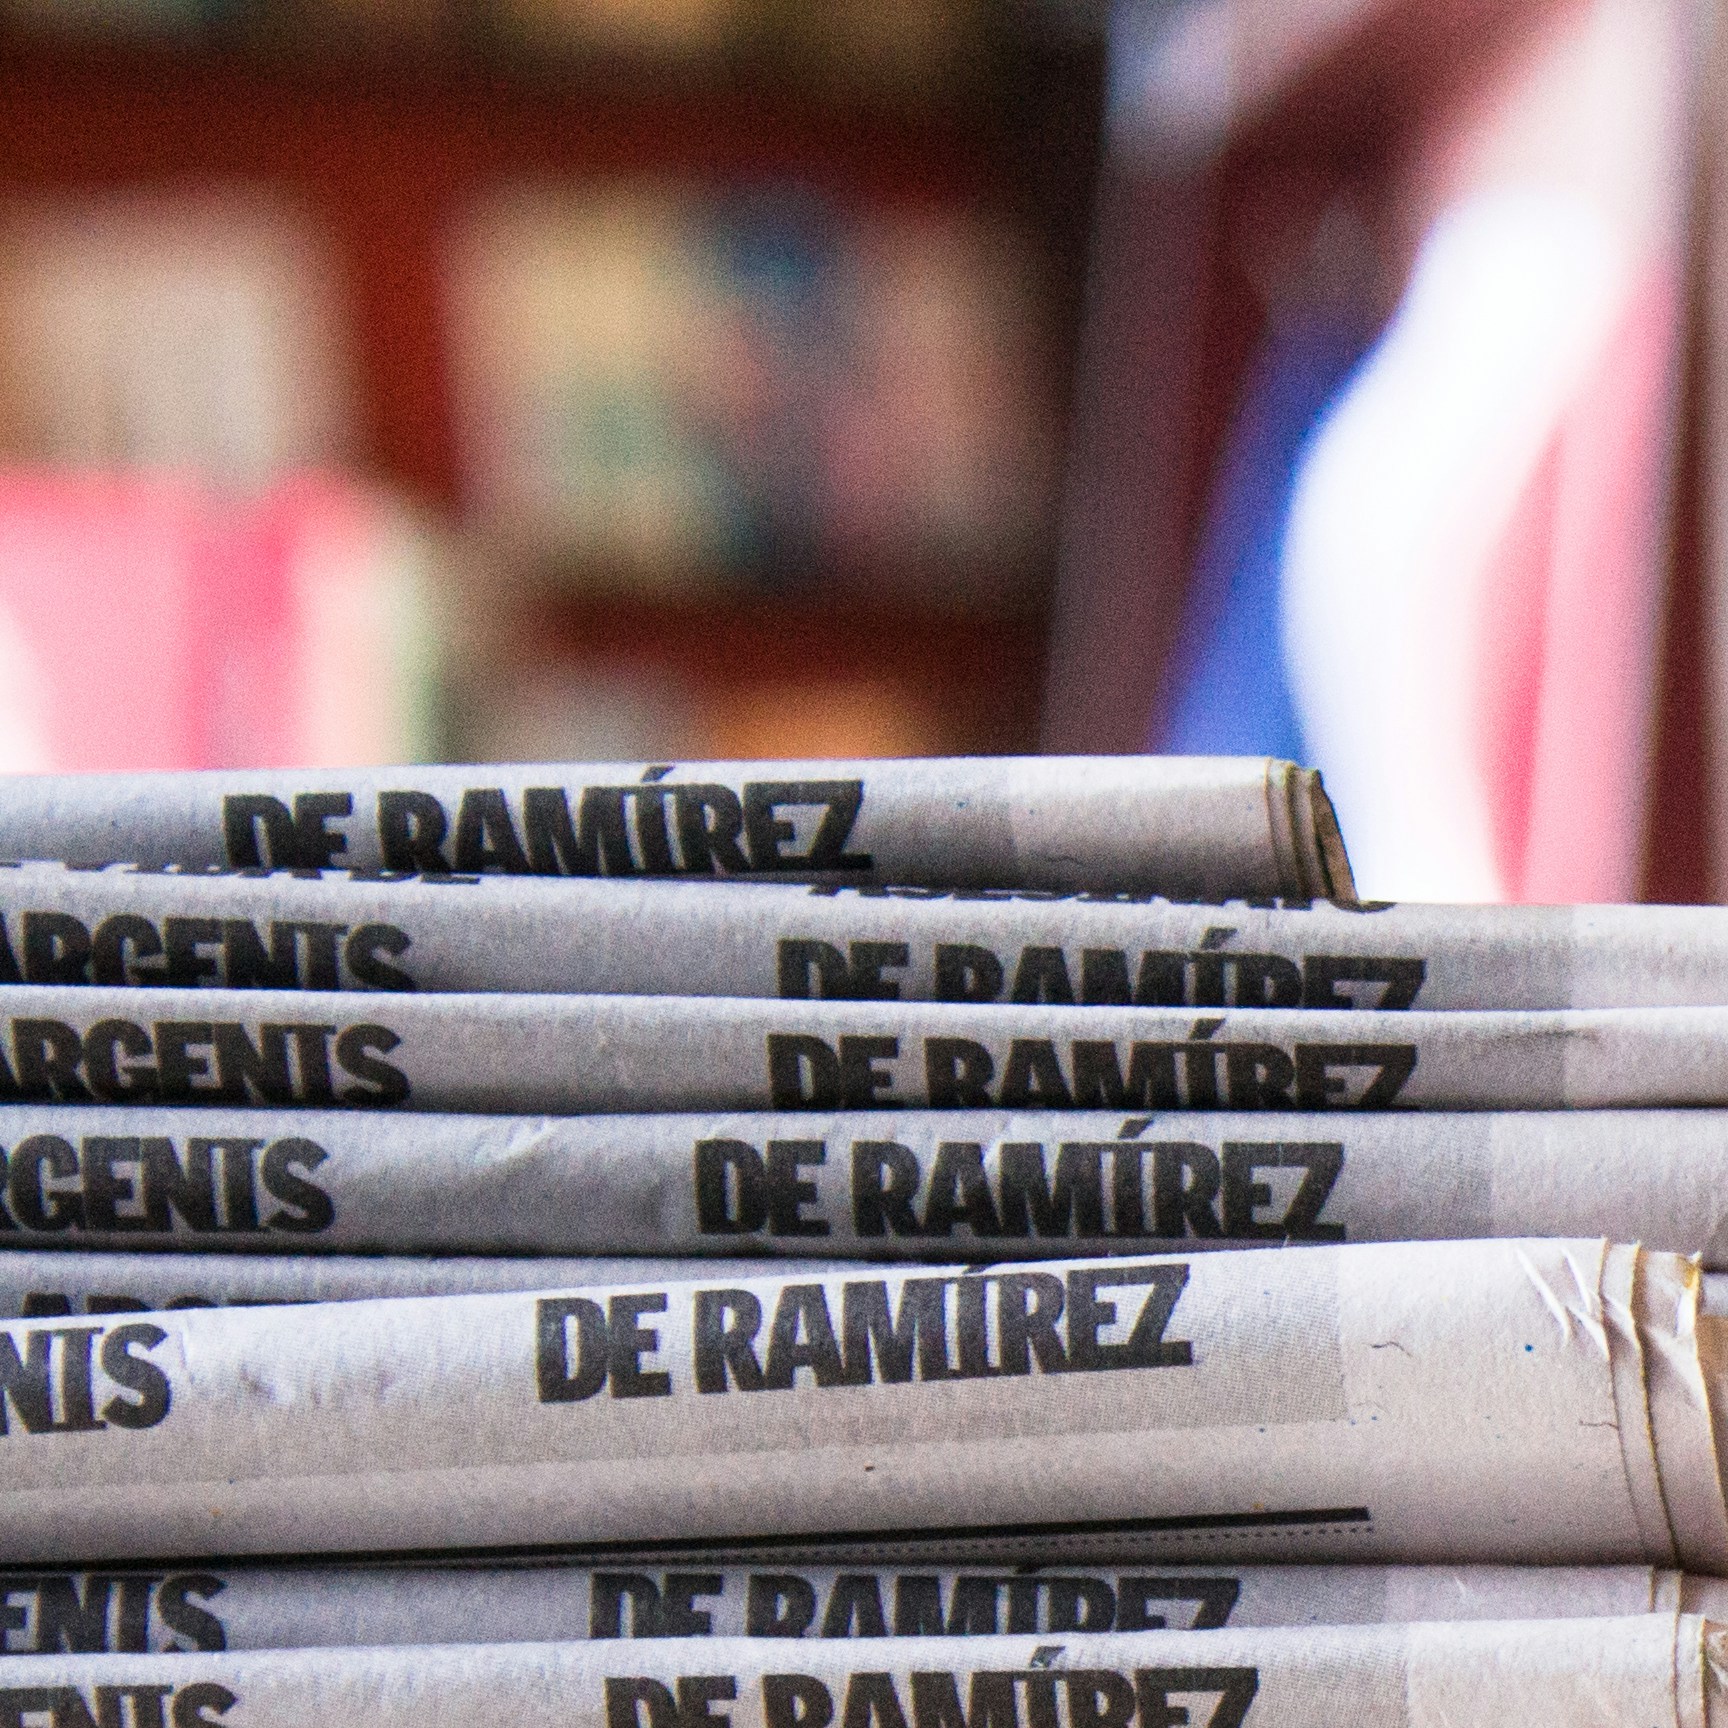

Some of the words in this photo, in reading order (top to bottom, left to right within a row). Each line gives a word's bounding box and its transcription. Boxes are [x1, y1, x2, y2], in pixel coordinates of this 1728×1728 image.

[223, 791, 354, 871] DE
[377, 764, 873, 876] RAMÍREZ
[766, 1033, 900, 1109] DE
[924, 1017, 1418, 1111] RAMÍREZ
[694, 1138, 830, 1236] DE
[851, 1117, 1346, 1241] RAMÍREZ
[536, 1292, 672, 1403] DE
[692, 1262, 1194, 1396] RAMÍREZ
